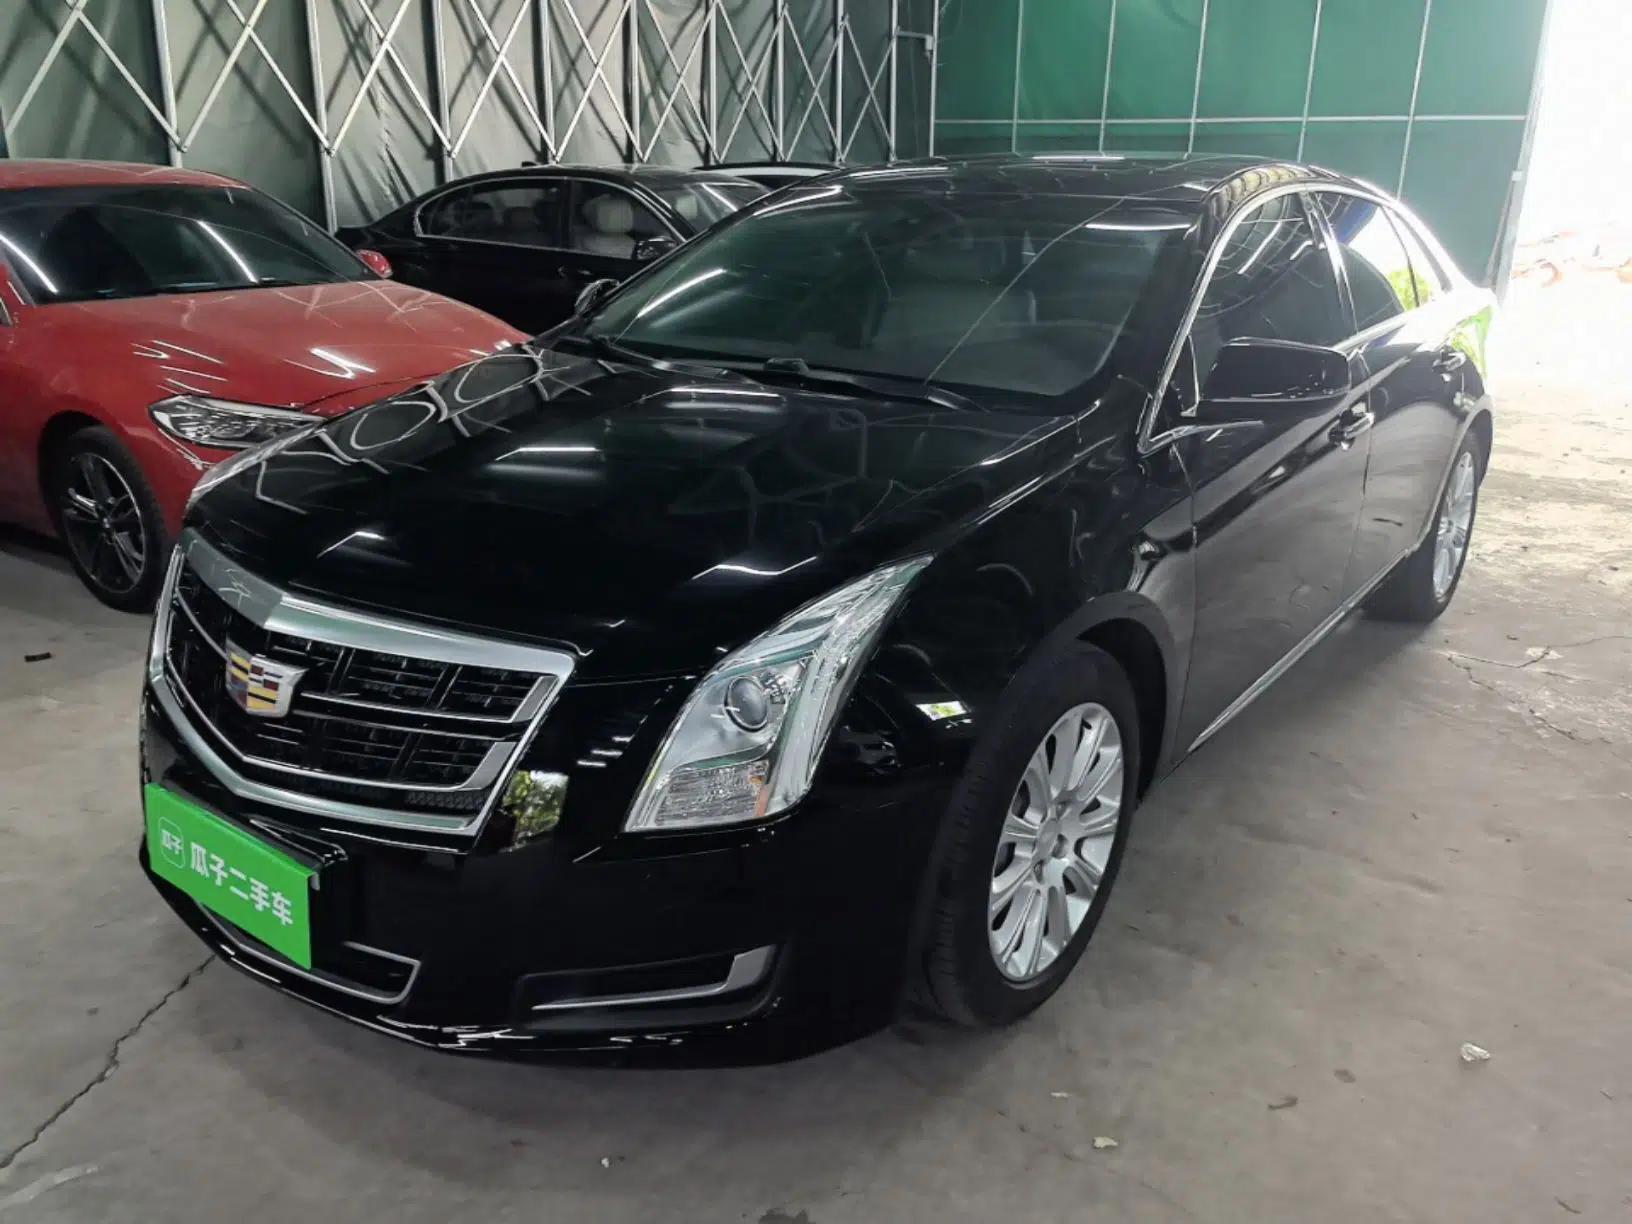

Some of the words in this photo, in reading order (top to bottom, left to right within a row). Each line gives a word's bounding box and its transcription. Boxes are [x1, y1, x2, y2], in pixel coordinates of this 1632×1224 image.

[190, 842, 293, 926] 瓜子二手车
